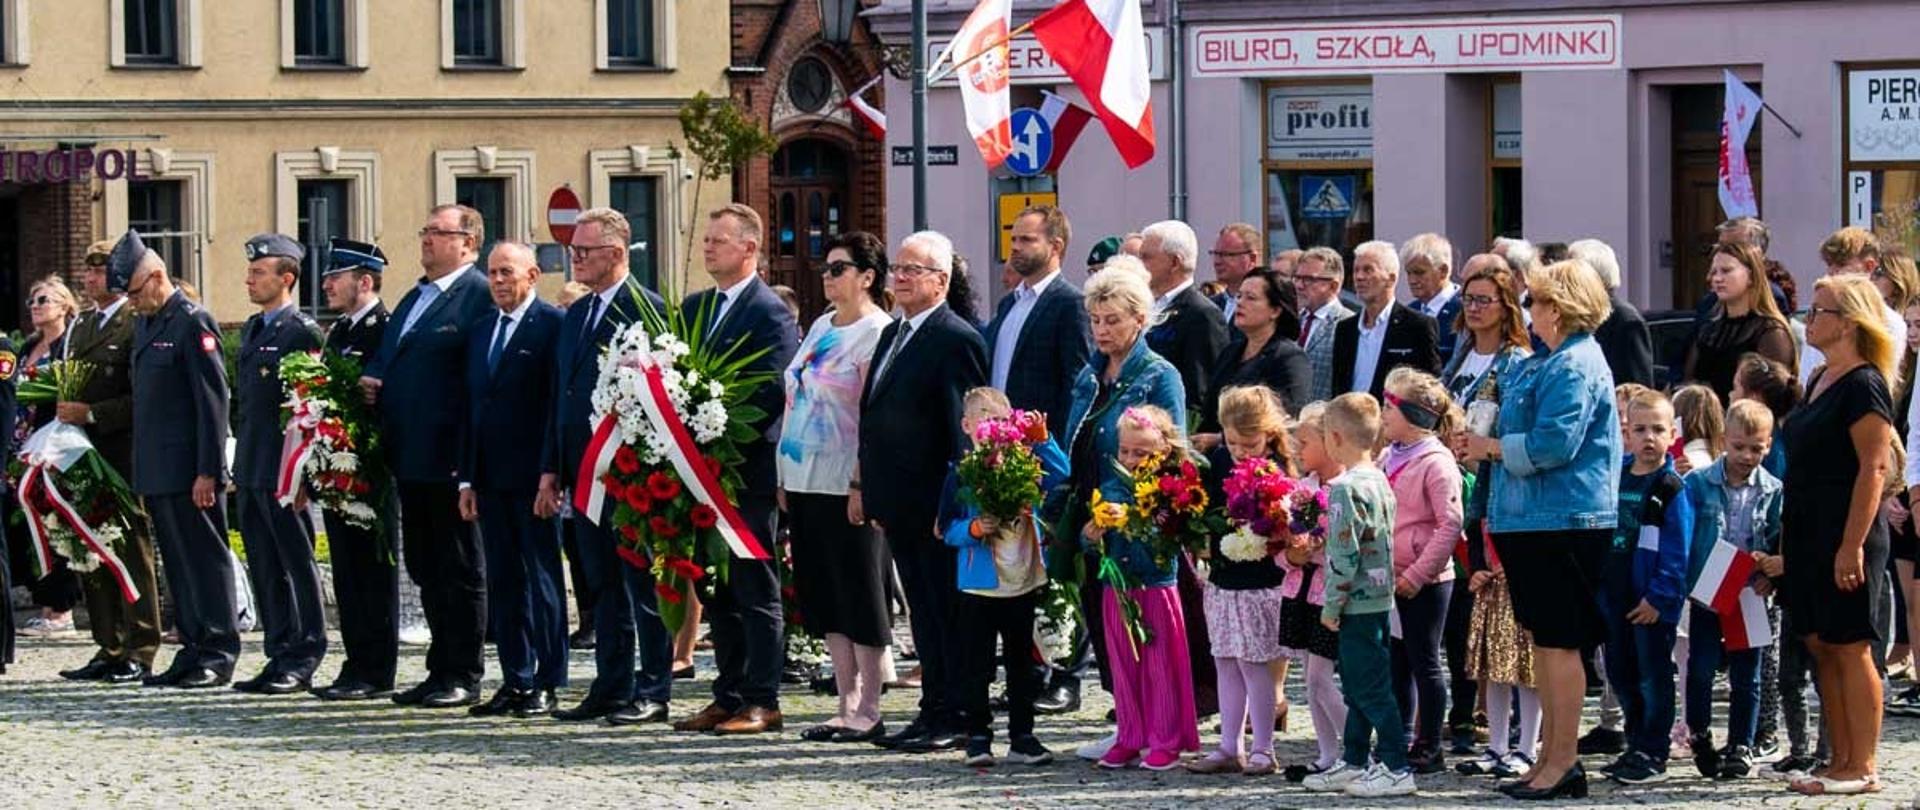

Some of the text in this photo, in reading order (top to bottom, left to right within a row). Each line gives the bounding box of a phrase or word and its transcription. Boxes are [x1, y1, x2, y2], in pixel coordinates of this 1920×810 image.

[1204, 31, 1607, 65] BIURO, SZKOŁA, UPOMINKI
[1868, 77, 1920, 104] PIER
[1287, 104, 1370, 136] profit
[1881, 106, 1915, 121] A. M.
